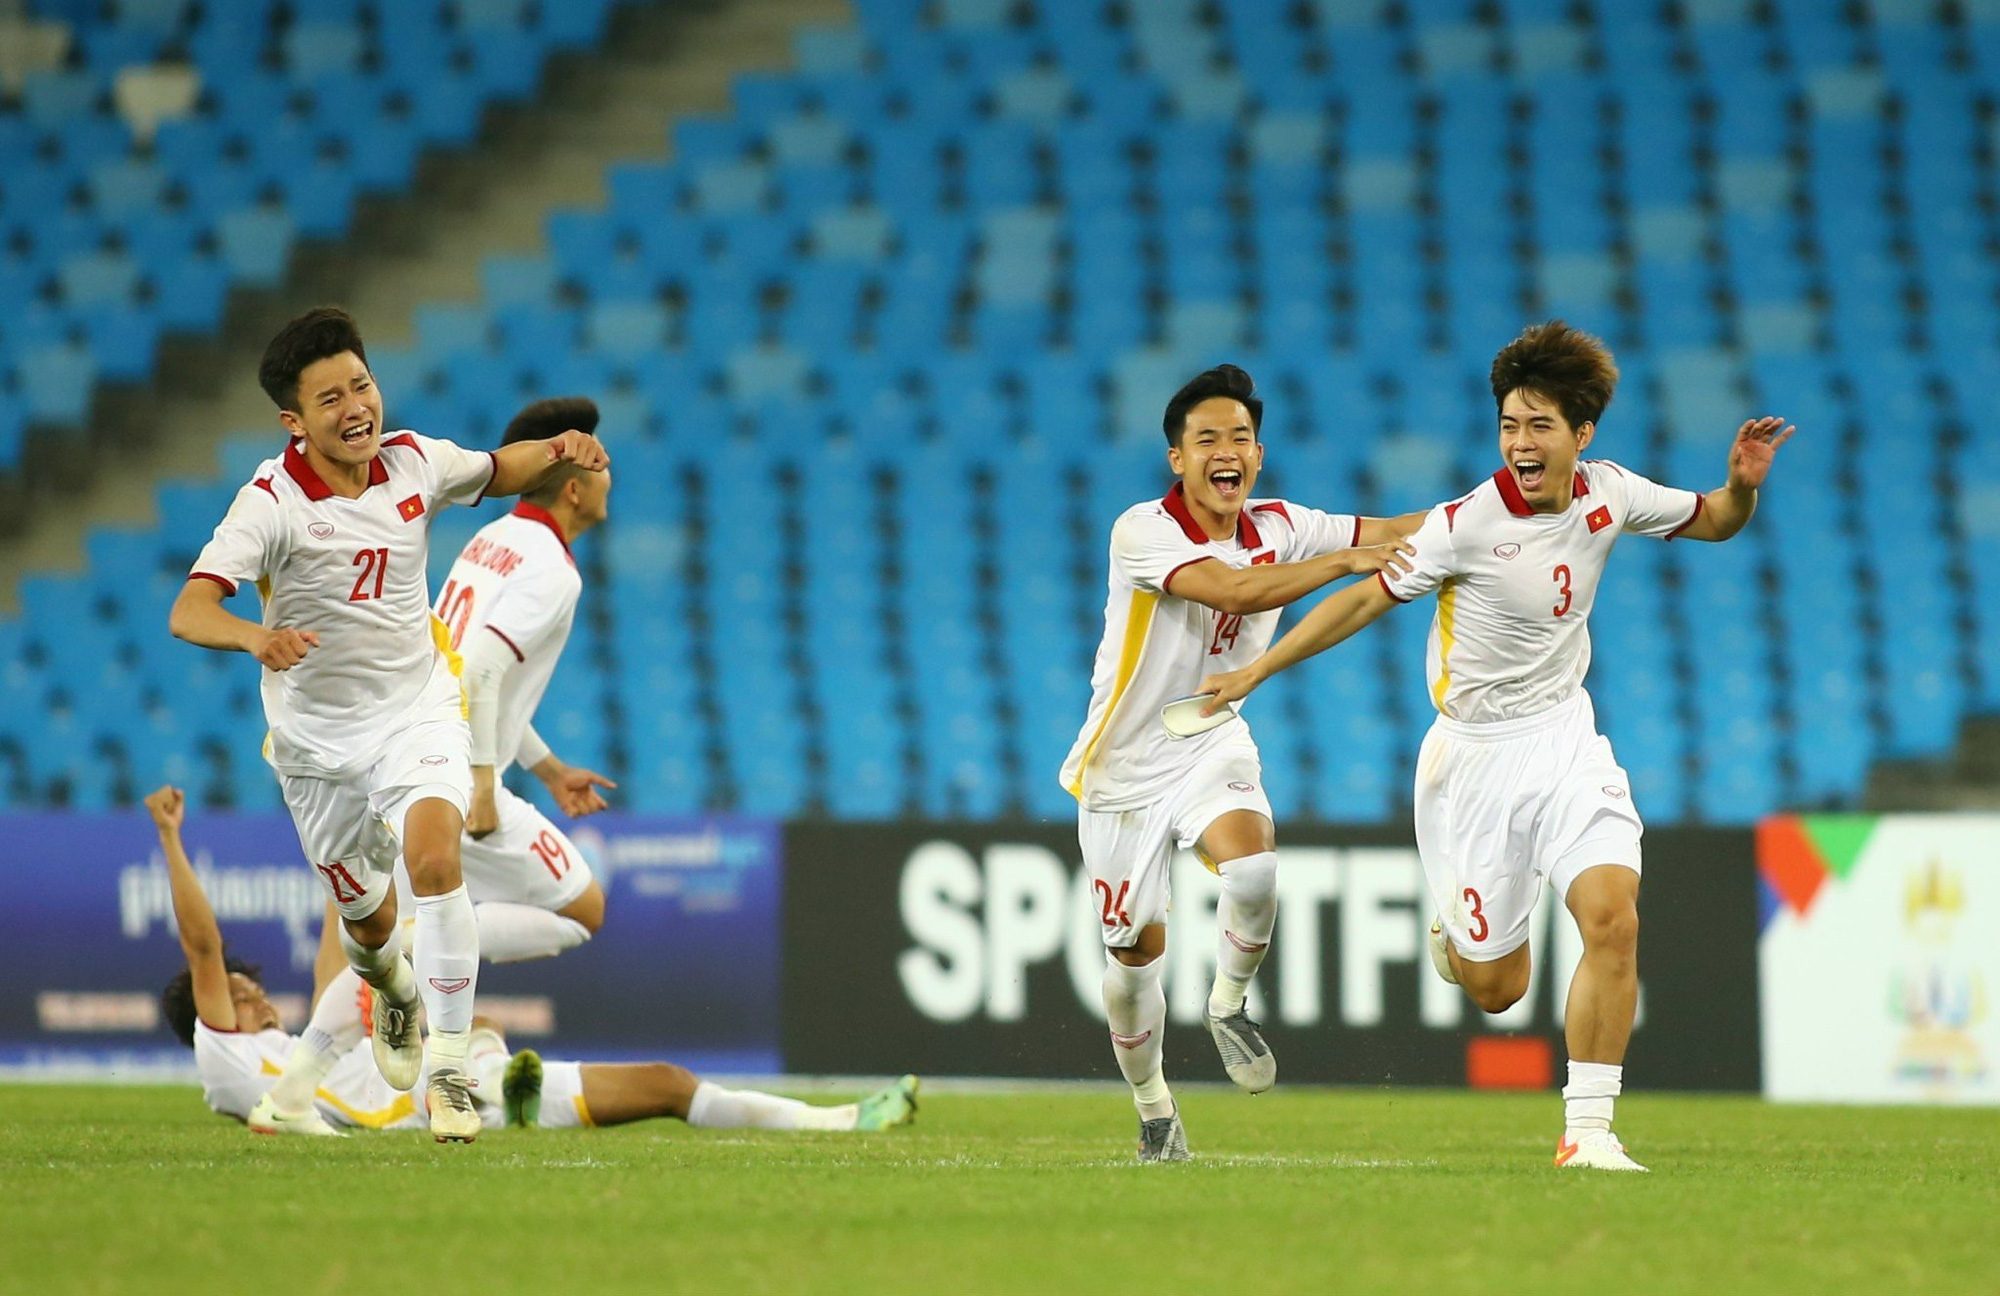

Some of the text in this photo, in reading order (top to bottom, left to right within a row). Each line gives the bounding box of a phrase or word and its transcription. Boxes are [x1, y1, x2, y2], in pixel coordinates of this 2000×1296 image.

[349, 547, 389, 601] 21
[1552, 564, 1572, 618] 3
[1209, 608, 1243, 656] 24
[529, 829, 571, 882] 19
[316, 862, 368, 904] 21
[1094, 878, 1132, 927] 24
[1463, 887, 1489, 943] 3
